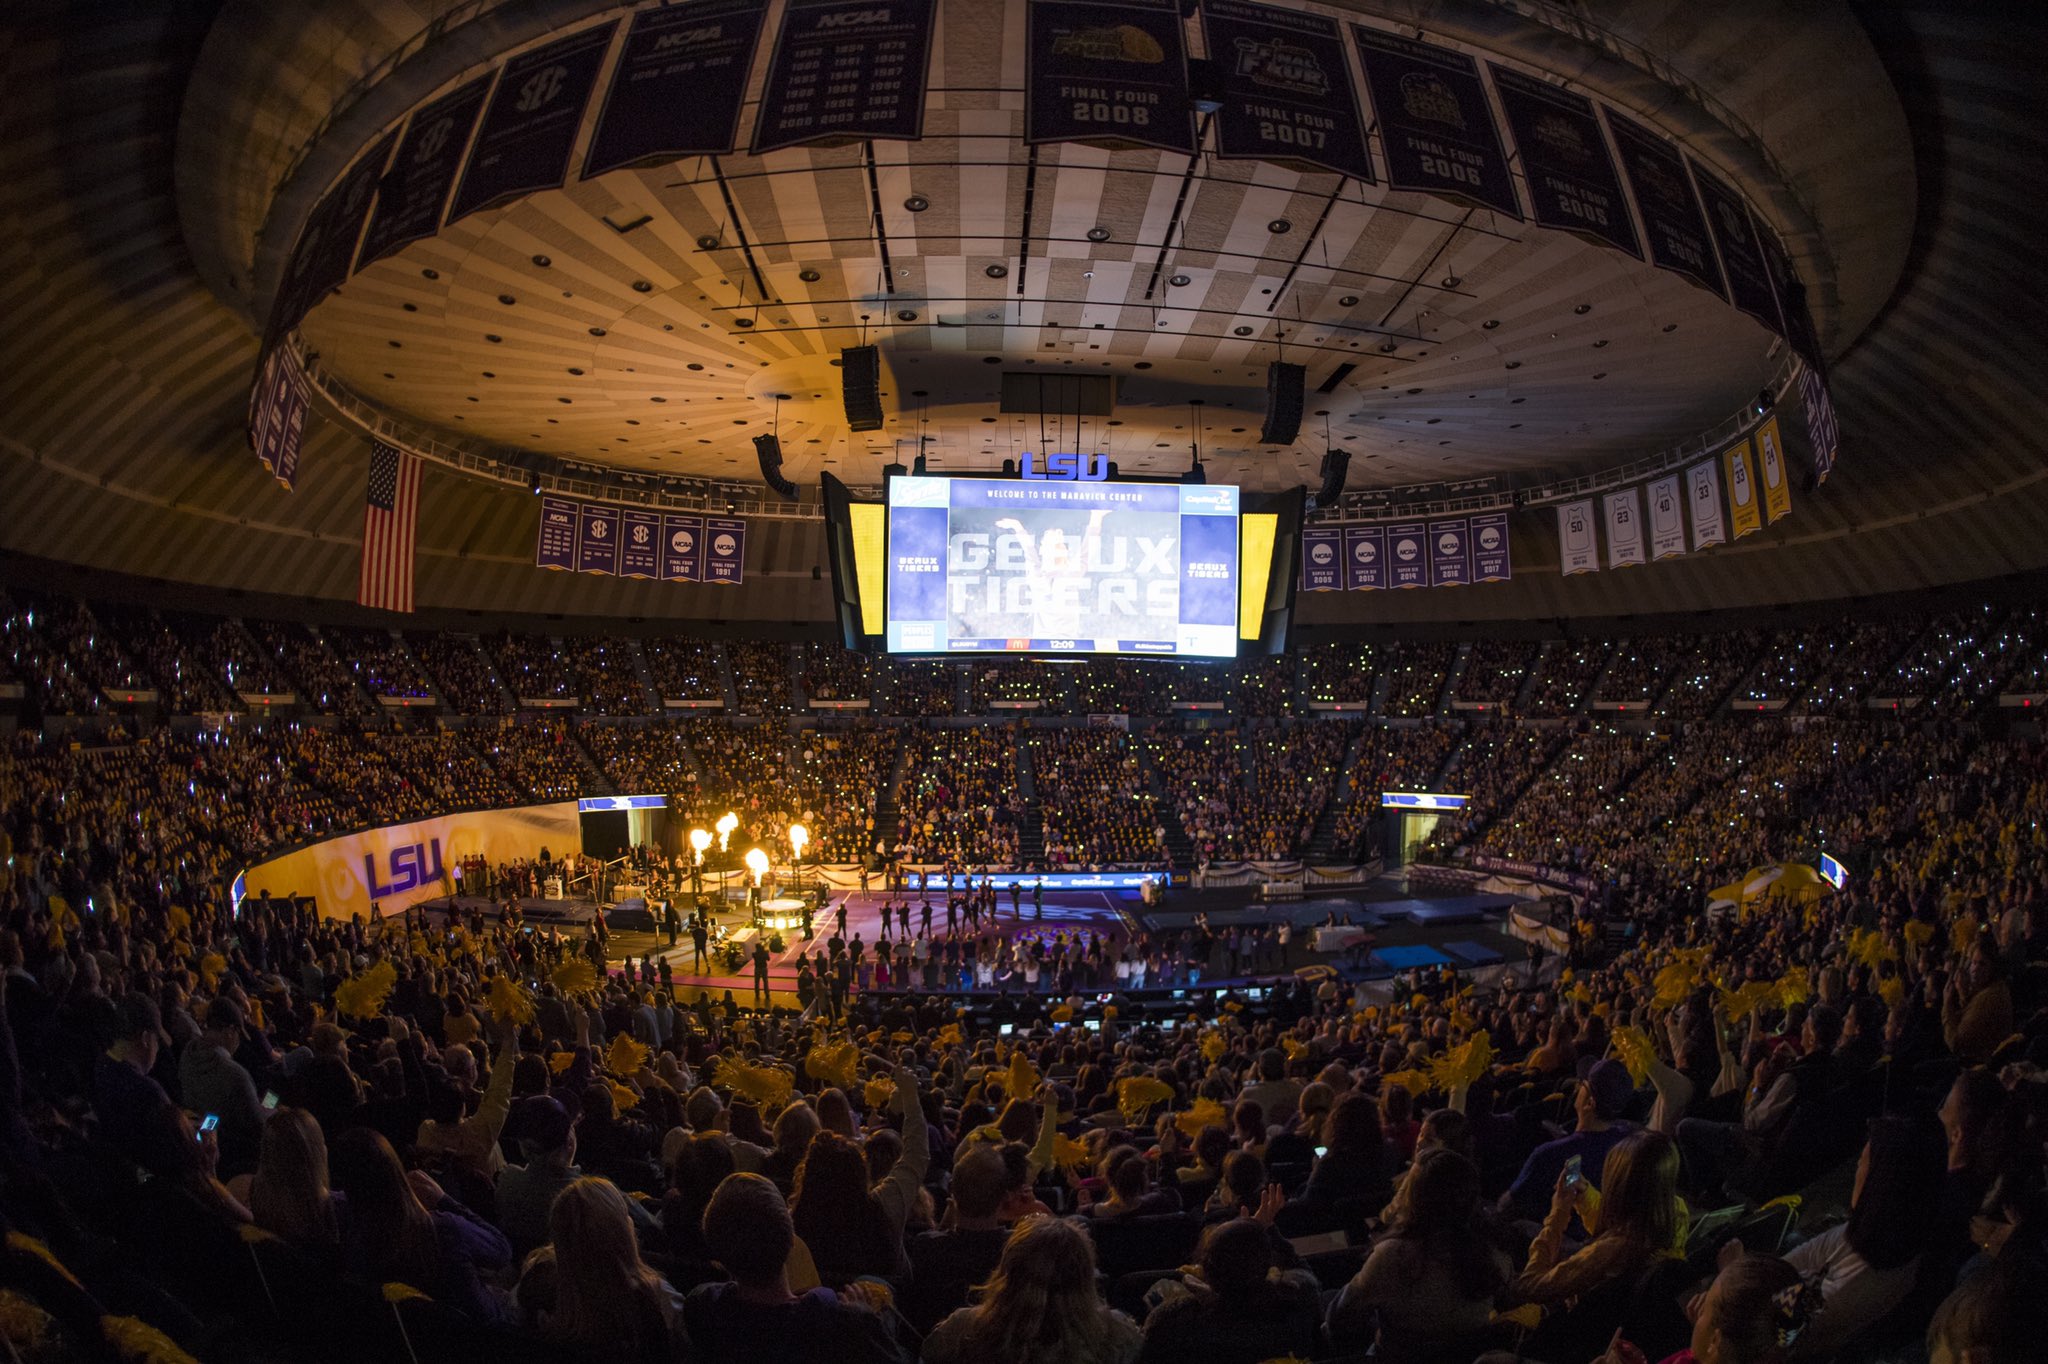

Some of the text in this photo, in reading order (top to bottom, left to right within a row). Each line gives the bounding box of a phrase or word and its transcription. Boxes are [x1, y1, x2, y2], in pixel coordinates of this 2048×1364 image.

[816, 9, 891, 29] NCAA
[651, 24, 722, 51] NCAA
[1061, 86, 1159, 104] FINAL FOUR
[1073, 102, 1150, 125] 2008
[1244, 104, 1334, 130] FINAL FOUR
[1260, 122, 1326, 149] 2007
[1407, 136, 1484, 167] FINAL FOUR
[1421, 154, 1482, 186] 2006
[1766, 448, 1775, 466] 34
[1022, 451, 1108, 482] LSU
[1735, 468, 1745, 484] 33
[987, 490, 1143, 502] WELCOME TO THE MARAVICH CENTER
[1699, 485, 1709, 500] 33
[1659, 499, 1670, 512] 40
[549, 512, 568, 523] NCAA
[1570, 520, 1583, 533] 50
[1617, 511, 1629, 524] 23
[591, 519, 609, 539] SEC
[632, 525, 650, 544] SEC
[1482, 537, 1500, 545] NCAA
[672, 566, 689, 574] 1990
[715, 568, 731, 576] 1991
[1400, 572, 1417, 580] 2014
[1484, 565, 1500, 574] 2017
[947, 576, 1179, 616] TIGERS
[1050, 640, 1075, 649] 12:09
[365, 837, 445, 901] LSU
